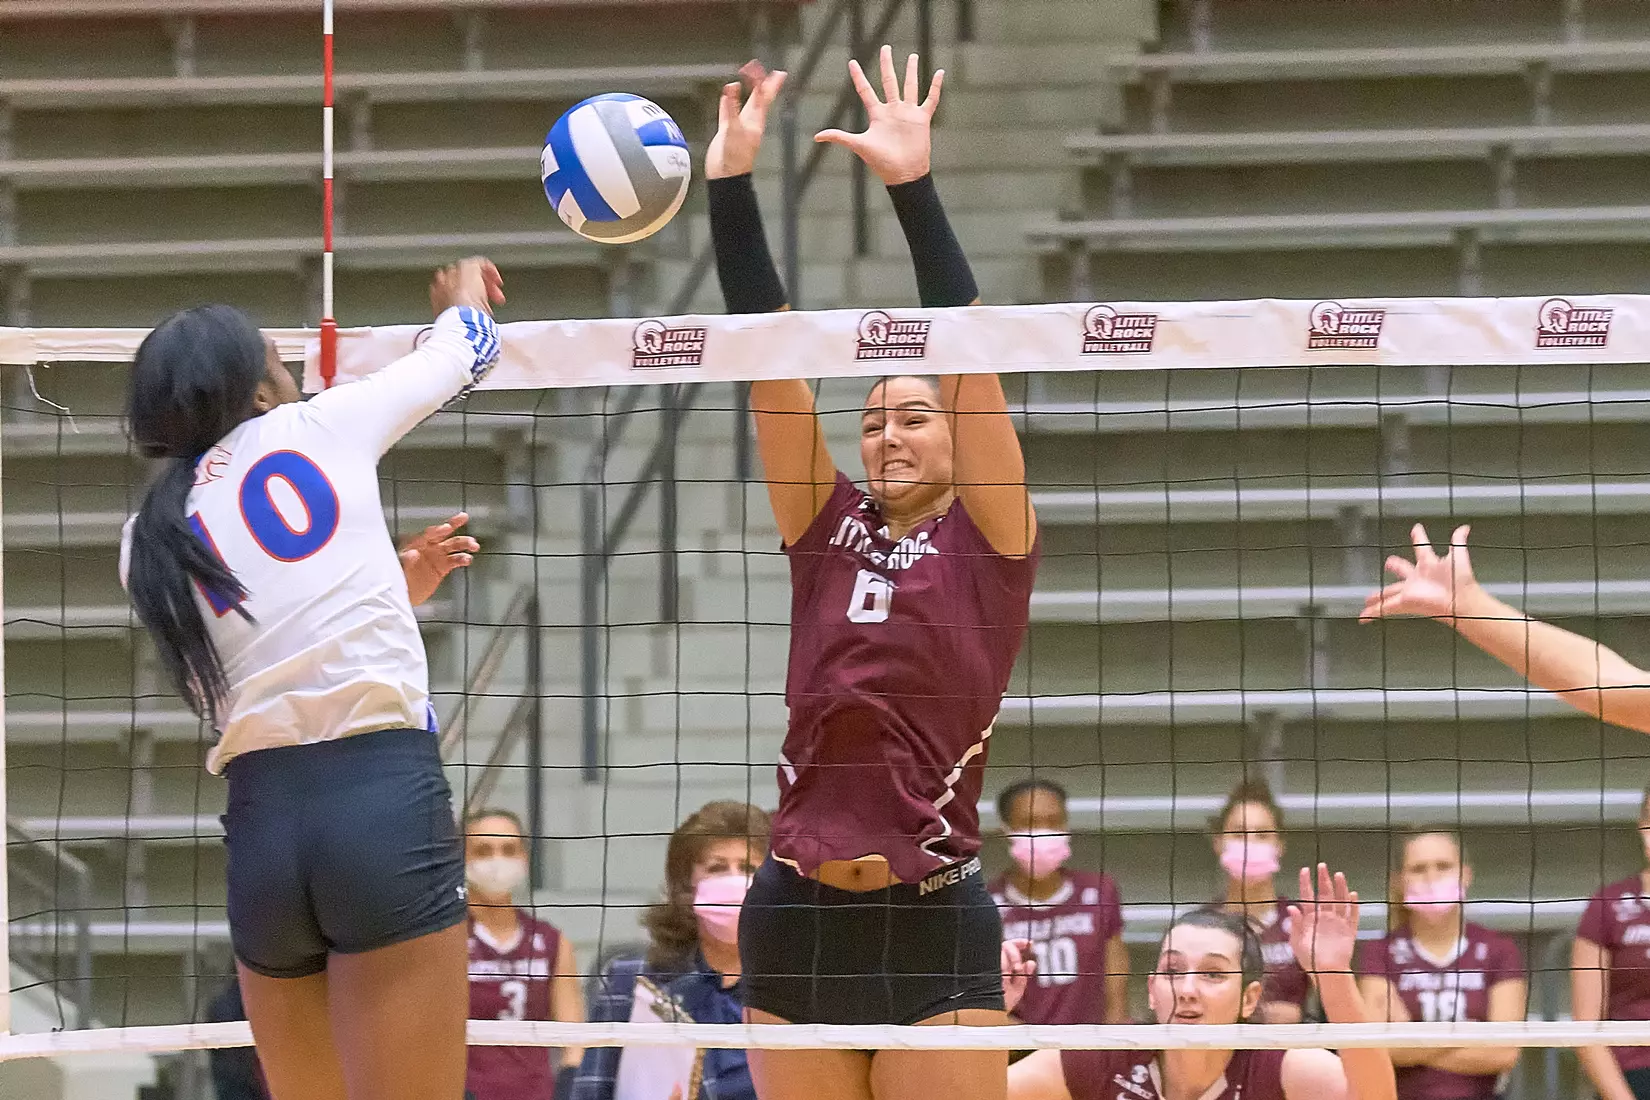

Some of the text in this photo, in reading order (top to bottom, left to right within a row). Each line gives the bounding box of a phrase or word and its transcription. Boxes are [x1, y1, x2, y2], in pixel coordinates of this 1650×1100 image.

[1115, 316, 1155, 328] LITTLE
[1340, 313, 1383, 324] LITTLE
[1569, 311, 1612, 322] LITTLE
[889, 322, 930, 333] LITTLE
[1338, 324, 1380, 334] ROCK
[1567, 322, 1608, 332] ROCK
[664, 330, 704, 341] LITTLE
[887, 334, 927, 344] ROCK
[1112, 328, 1153, 339] ROCK
[662, 341, 703, 352] ROCK
[1310, 338, 1376, 347] VOLLEYBALL
[1539, 336, 1604, 346] VOLLEYBALL
[1084, 342, 1150, 352] VOLLEYBALL
[859, 348, 923, 358] VOLLEYBALL
[635, 355, 700, 367] VOLLEYBALL
[846, 568, 899, 623] 6
[920, 868, 961, 896] NIKE
[1032, 937, 1079, 988] 10
[498, 980, 528, 1021] 3
